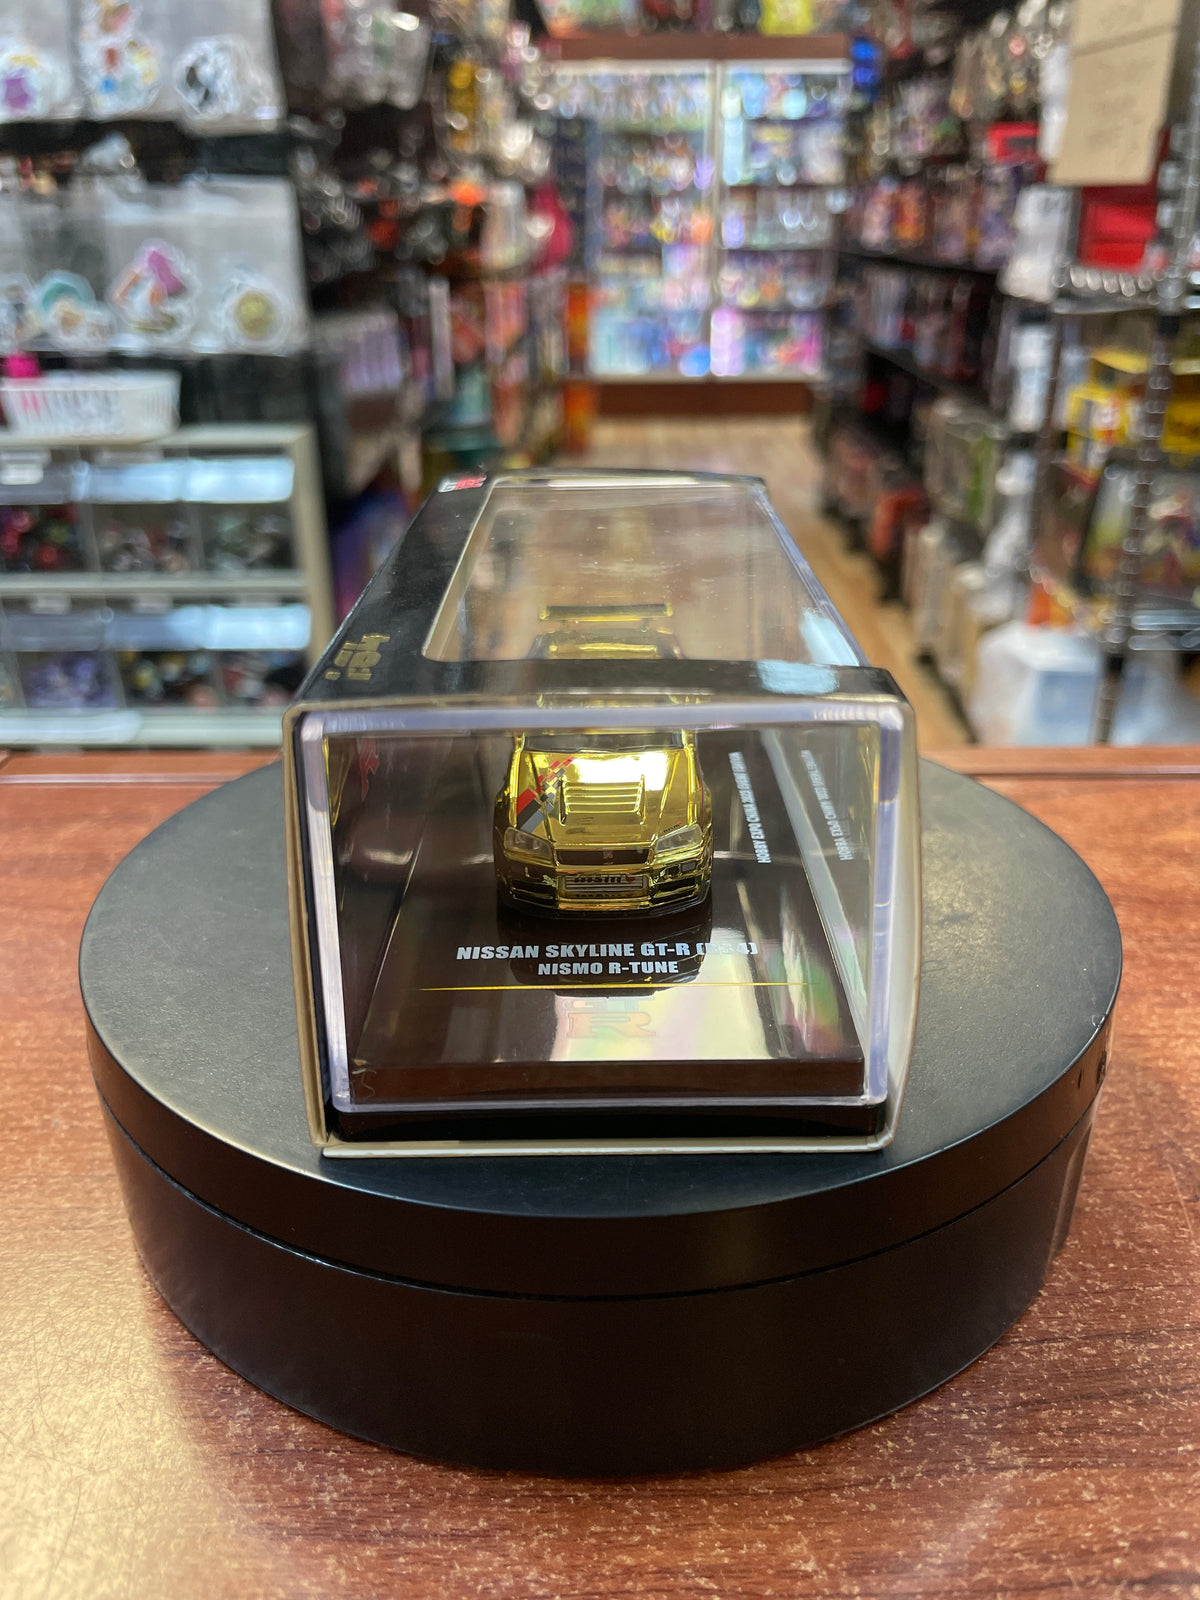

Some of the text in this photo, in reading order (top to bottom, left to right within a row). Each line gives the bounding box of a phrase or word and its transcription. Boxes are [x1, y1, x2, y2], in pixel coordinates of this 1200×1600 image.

[456, 945, 539, 960] NISSAN
[545, 943, 634, 958] SKYLINE
[640, 942, 690, 956] GT-R
[538, 961, 679, 975] NISMO R-TUNE
